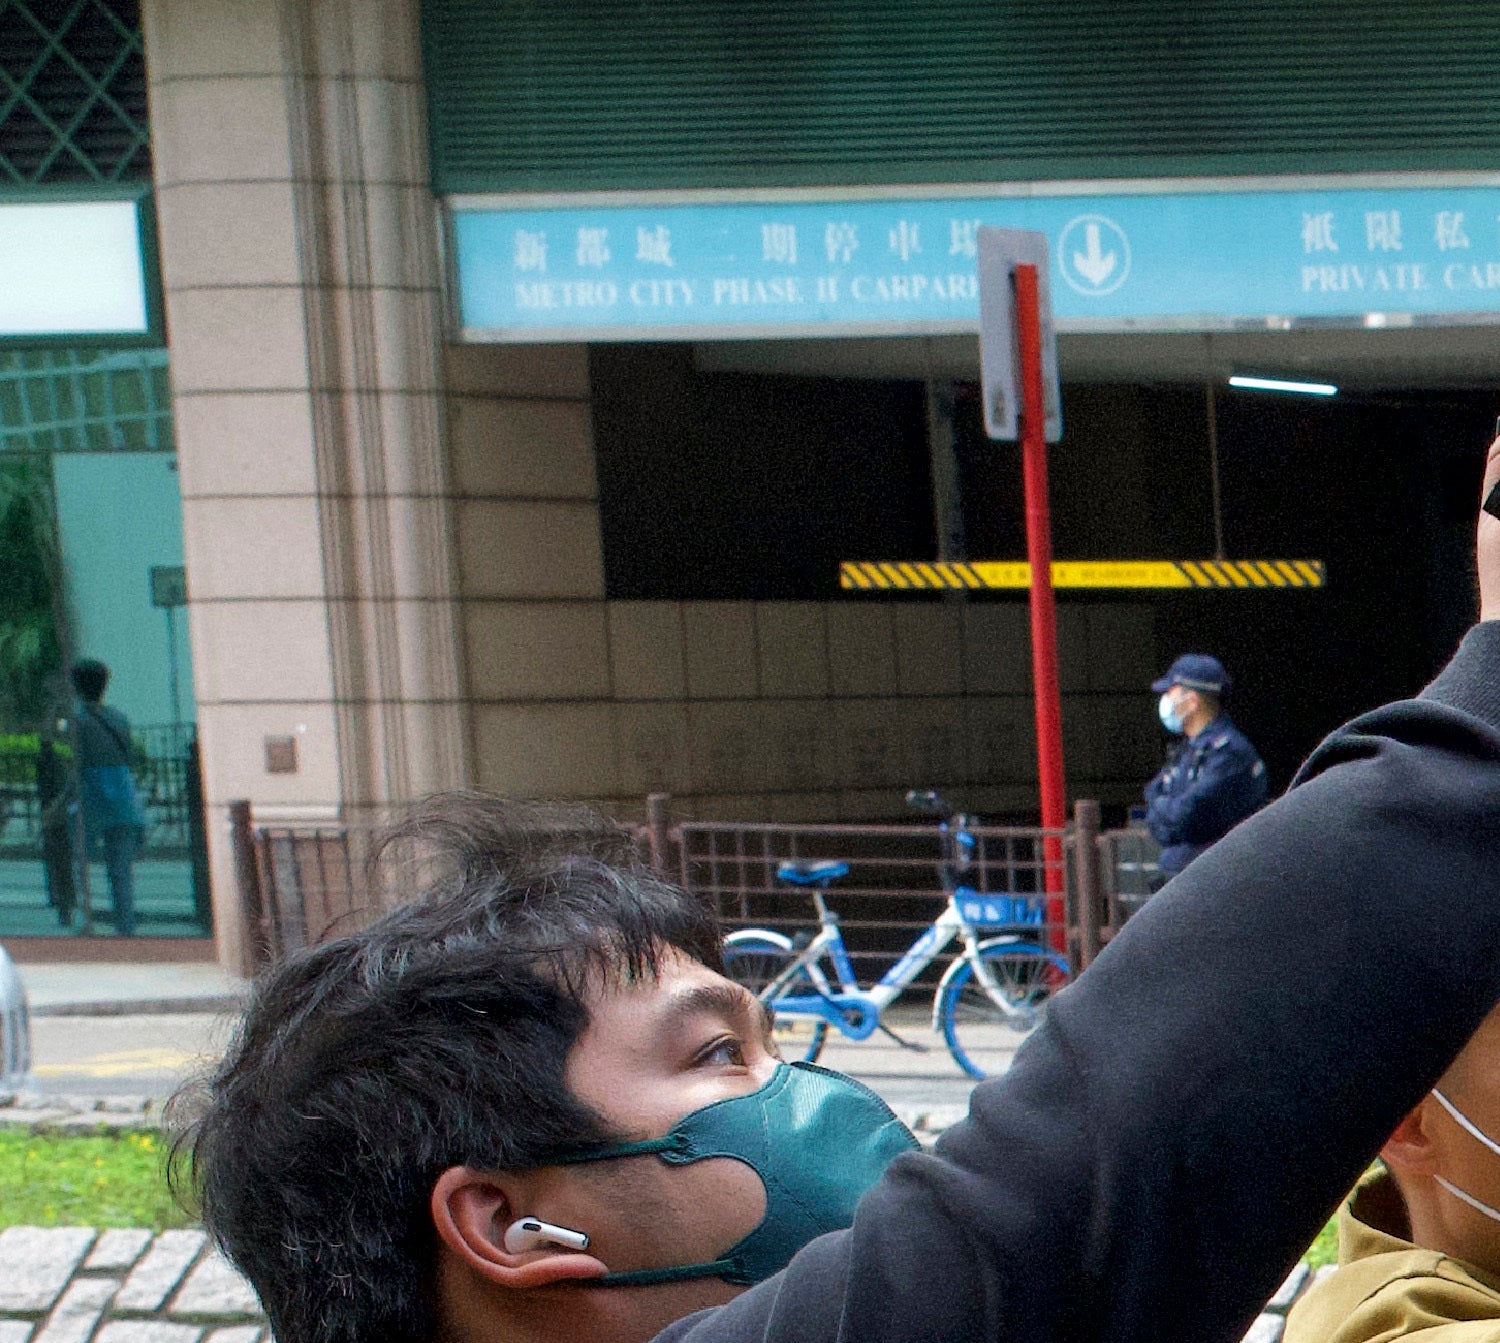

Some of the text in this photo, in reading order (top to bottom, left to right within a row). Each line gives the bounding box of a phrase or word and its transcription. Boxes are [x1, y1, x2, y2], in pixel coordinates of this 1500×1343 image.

[515, 278, 617, 308] METRO
[630, 277, 696, 306] CITY
[713, 275, 802, 306] PHASE
[1302, 261, 1426, 292] PRIVATE
